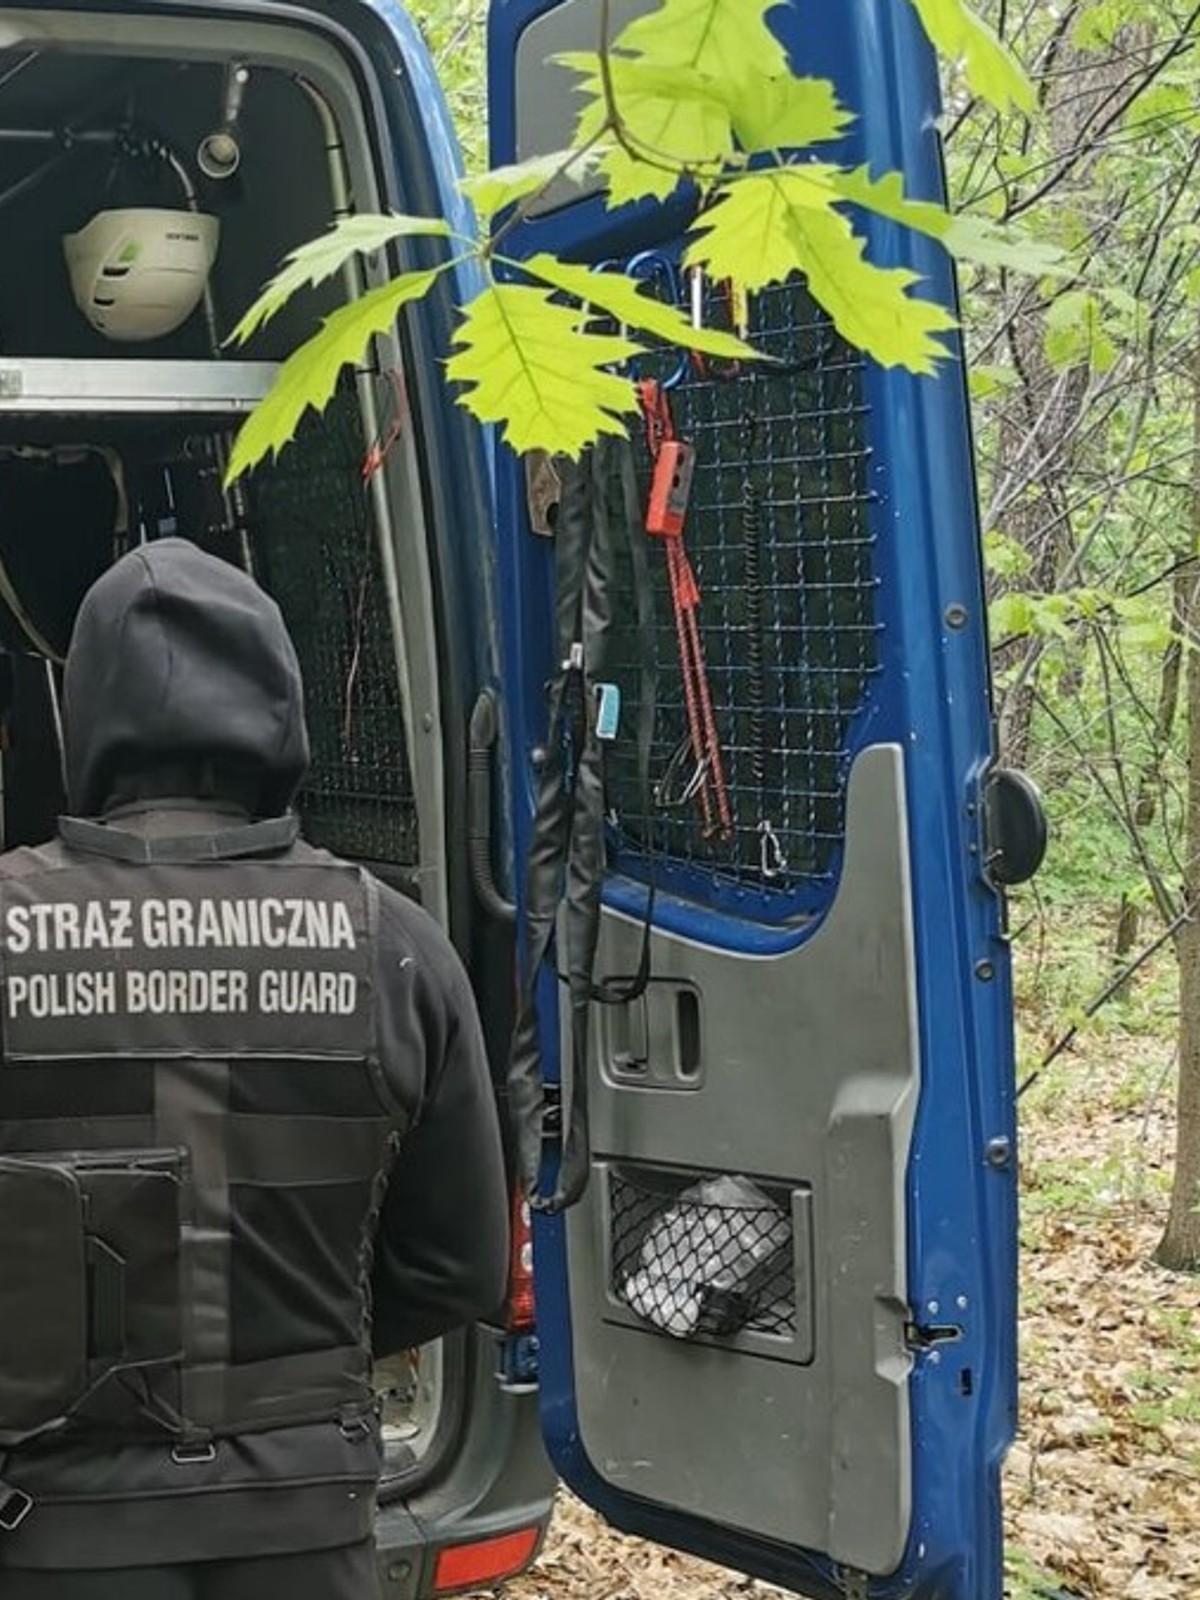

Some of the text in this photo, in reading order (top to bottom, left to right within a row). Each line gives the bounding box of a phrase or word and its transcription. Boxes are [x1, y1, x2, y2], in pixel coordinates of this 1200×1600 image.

[141, 898, 356, 950] GRANICZNA
[8, 969, 357, 1018] POLISH BORDER GUARD
